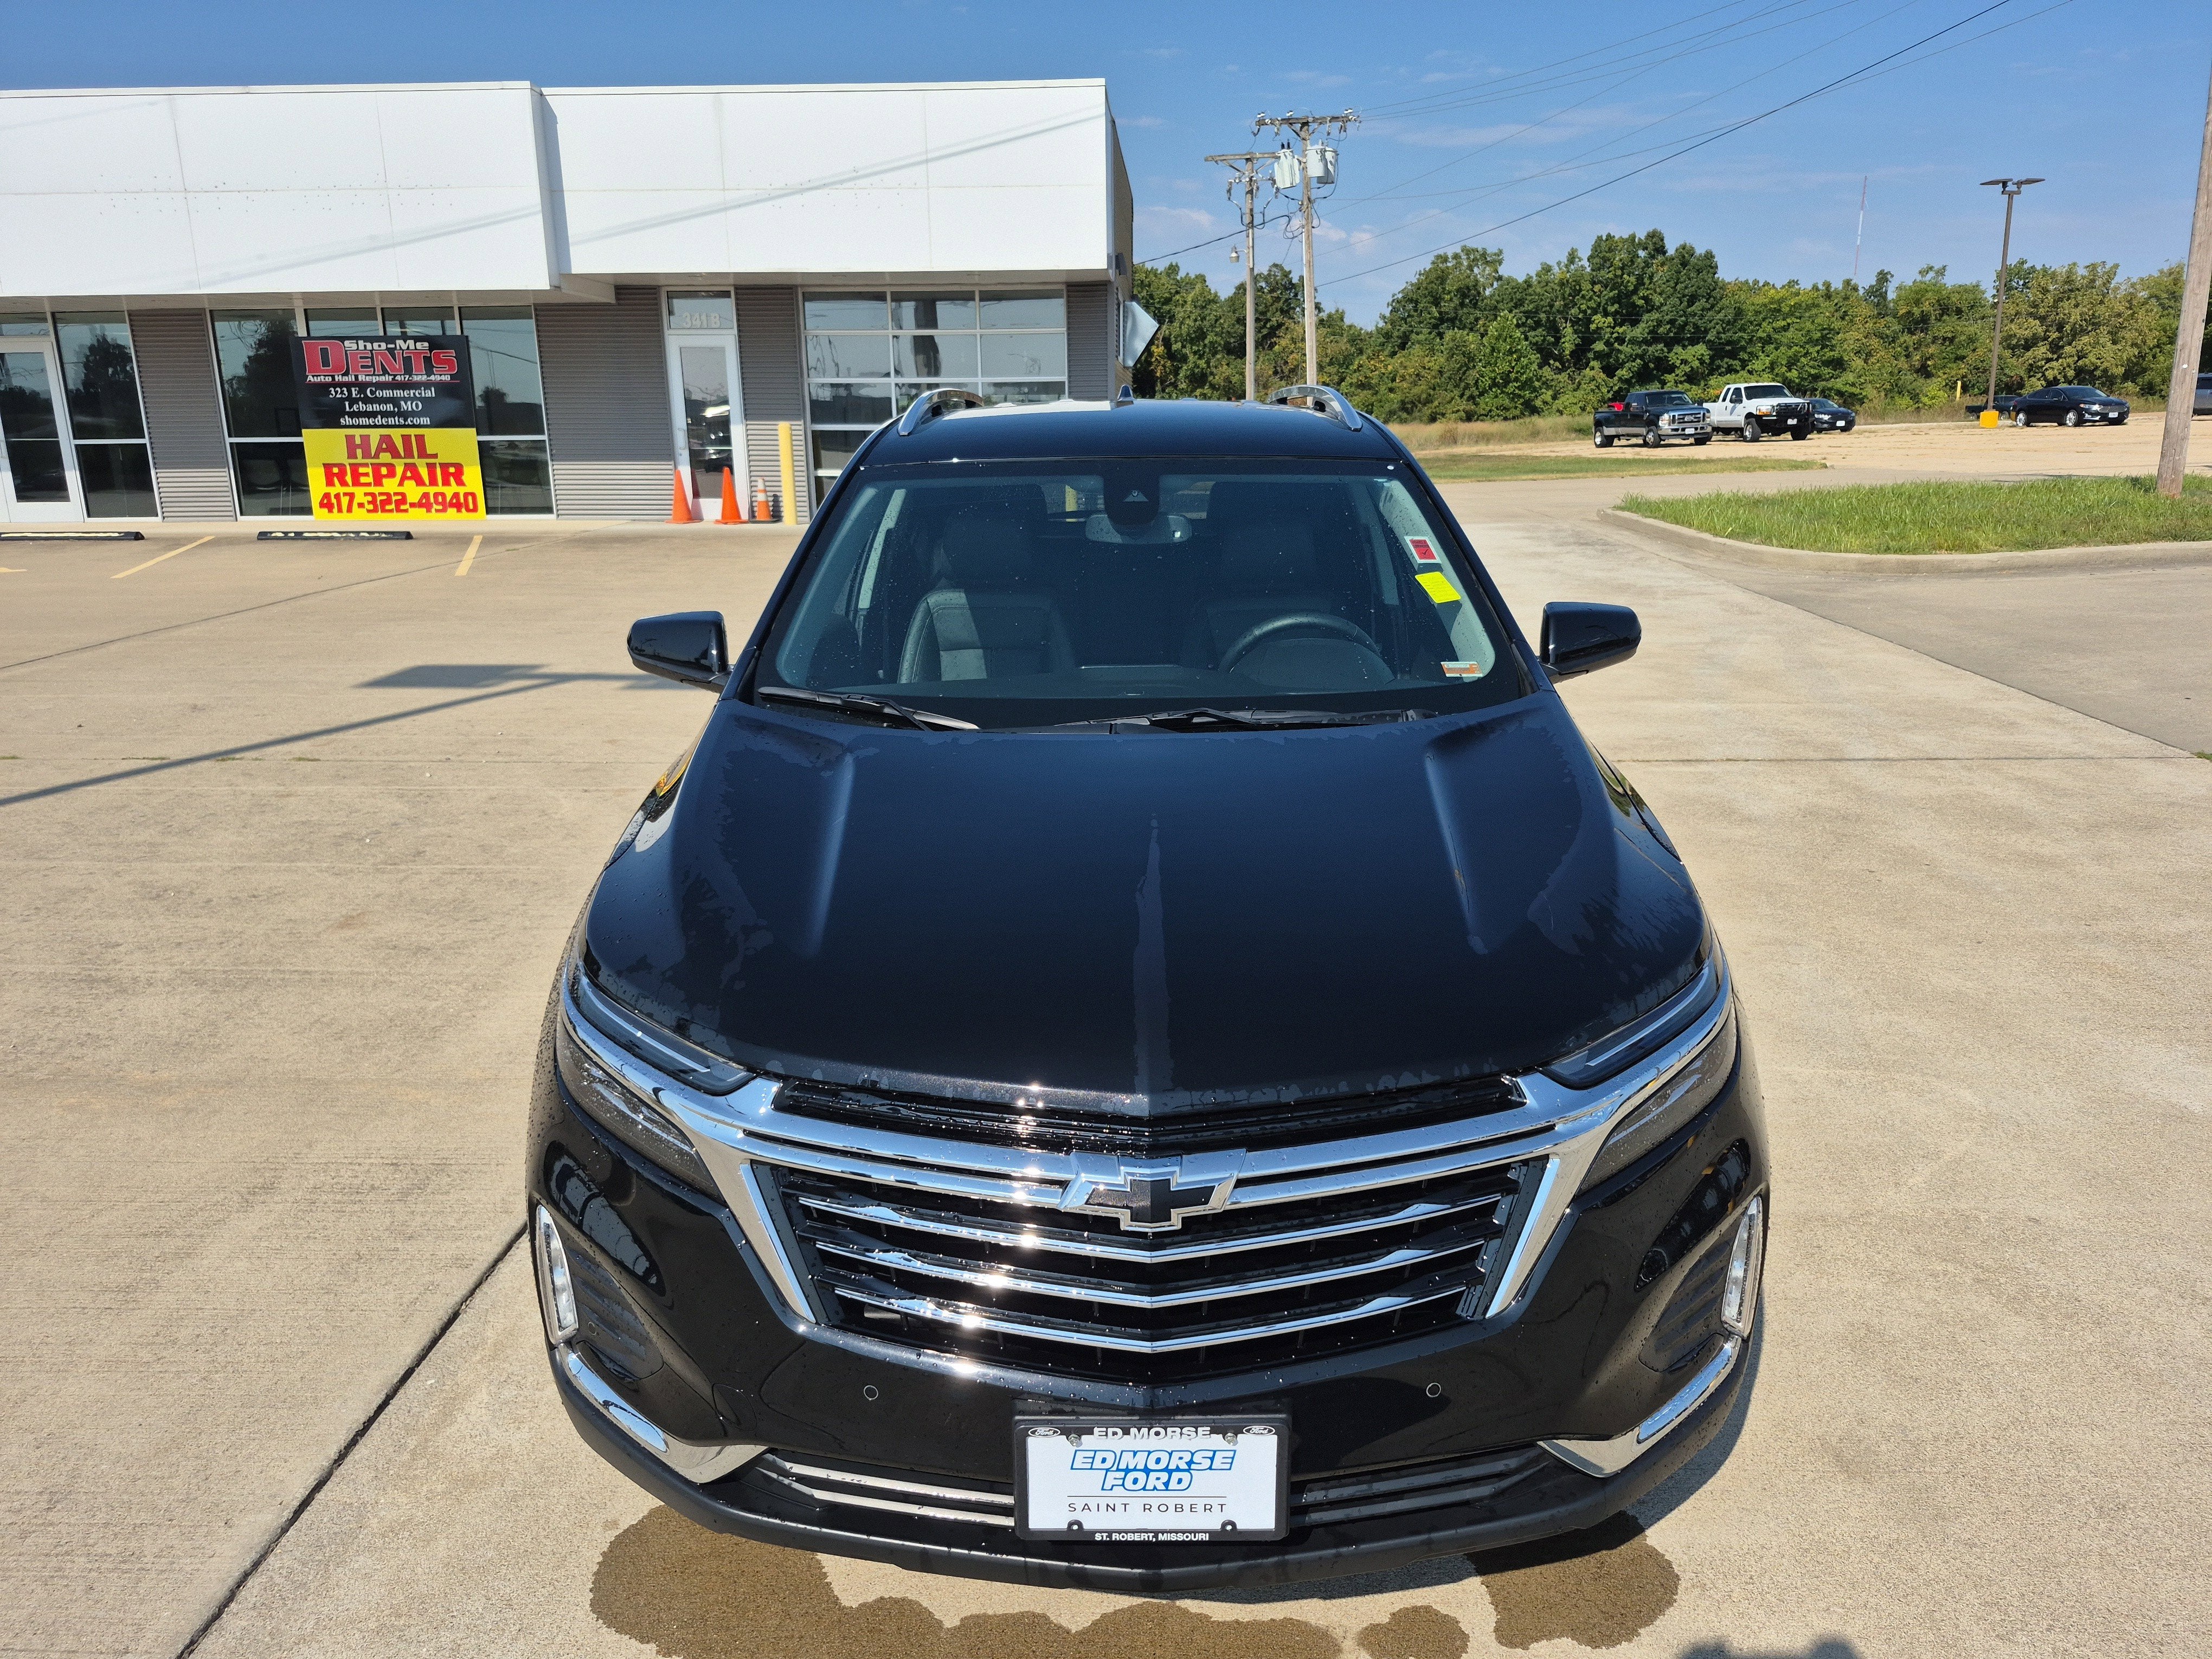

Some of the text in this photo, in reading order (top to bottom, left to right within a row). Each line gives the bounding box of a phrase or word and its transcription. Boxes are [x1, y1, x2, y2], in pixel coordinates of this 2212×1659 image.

[683, 312, 721, 328] 3418
[344, 339, 429, 350] Sho-Me
[302, 340, 458, 375] DENTS
[335, 374, 355, 382] Hail
[358, 374, 394, 383] Repair
[329, 386, 436, 398] 323 E. Commercial
[344, 400, 422, 413] Lebanon, MO
[340, 415, 431, 426] shomedents.com
[345, 434, 439, 459] HAIL
[322, 462, 467, 487] REPAIR
[319, 492, 479, 513] 417-322-4940
[1093, 1427, 1211, 1440] ED MORSE
[1070, 1450, 1237, 1471] ED MORSE
[1101, 1470, 1193, 1491] FORD
[1068, 1503, 1227, 1513] SAINT ROBERT
[1095, 1533, 1209, 1542] ST. ROBERT, MISSOURI
